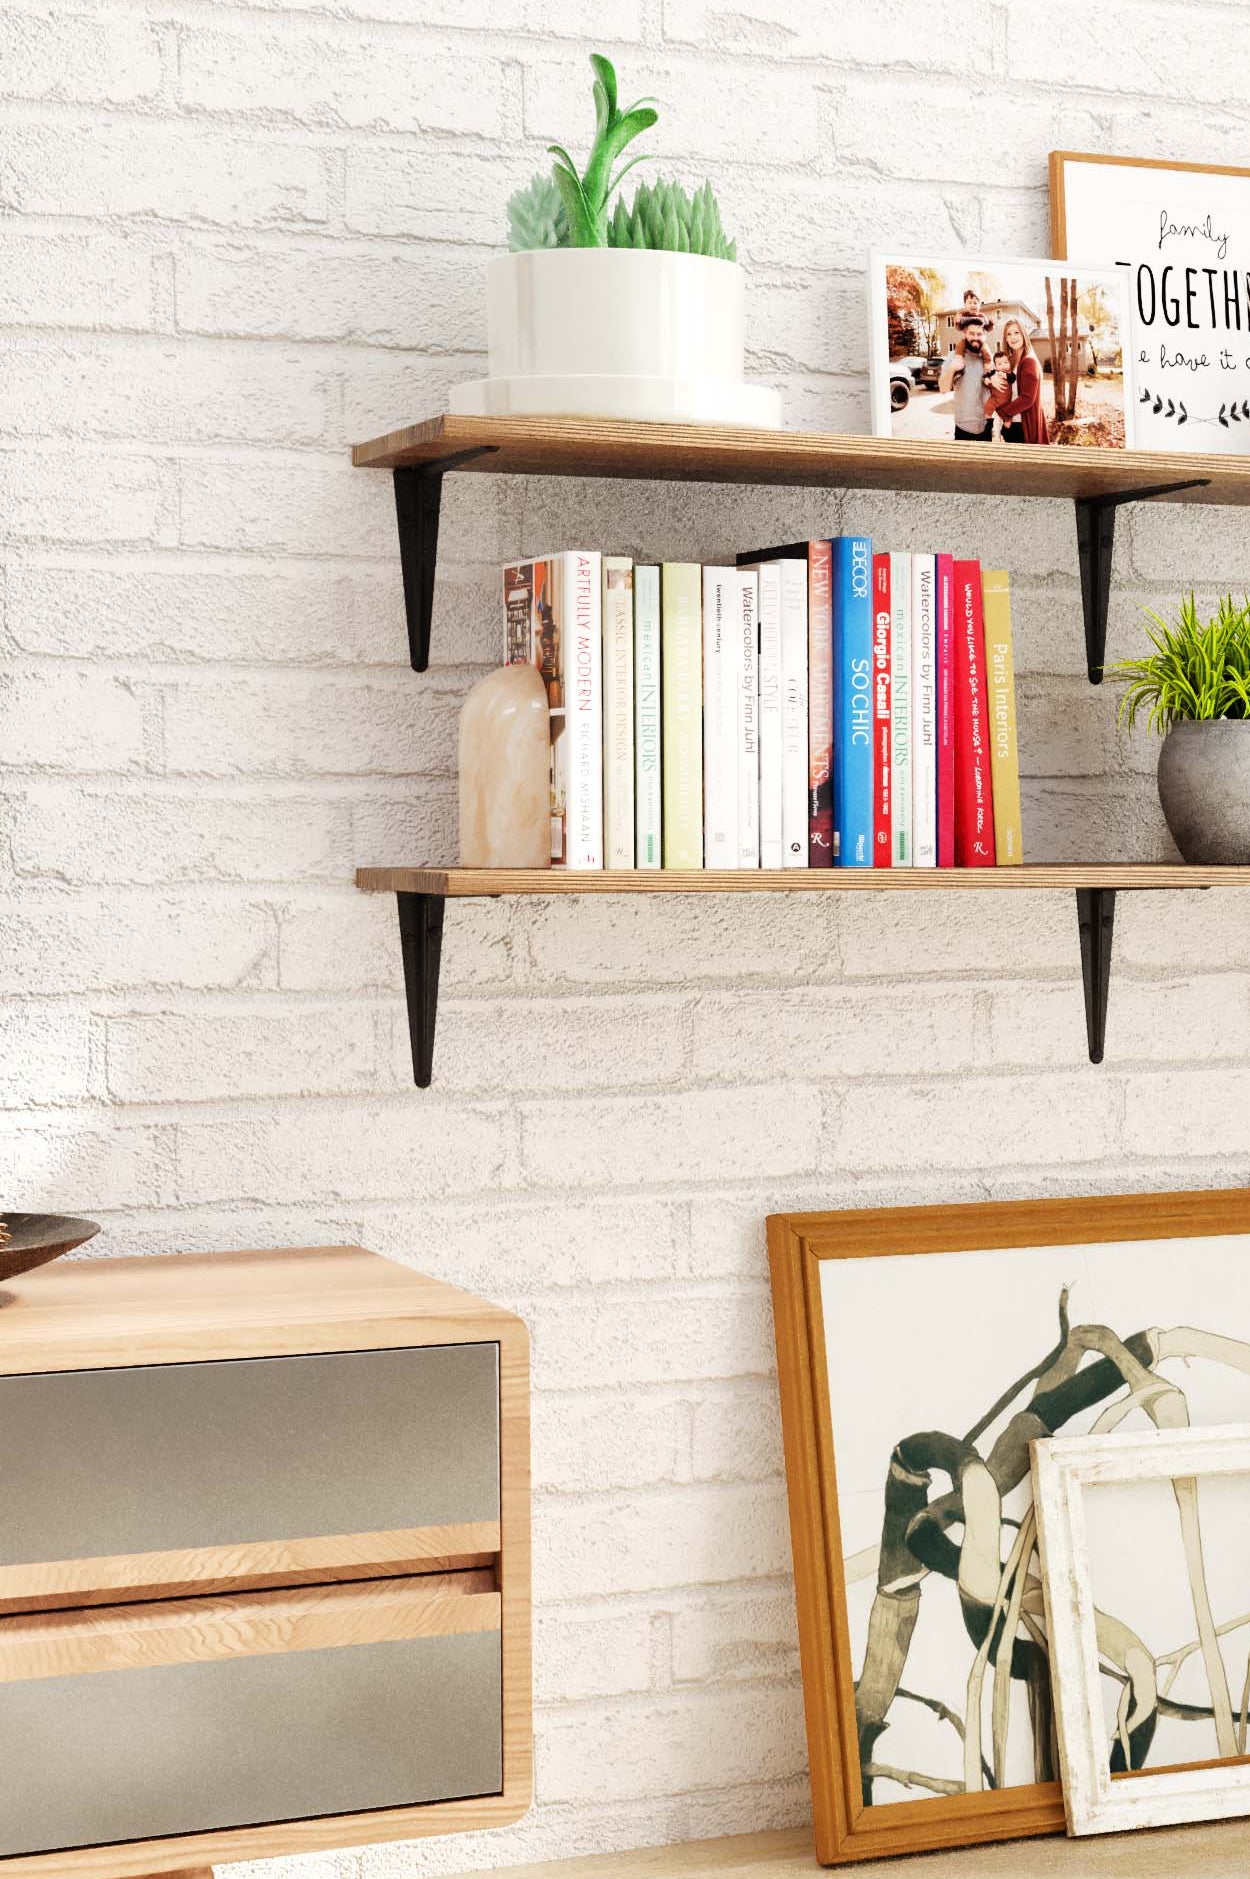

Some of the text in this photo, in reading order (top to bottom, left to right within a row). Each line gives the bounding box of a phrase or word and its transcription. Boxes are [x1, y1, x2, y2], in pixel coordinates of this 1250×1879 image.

[1158, 210, 1230, 260] family
[1138, 350, 1150, 363] e
[1160, 343, 1210, 372] have
[1220, 349, 1237, 370] it
[576, 556, 592, 631] ARTFULLY
[963, 583, 974, 617] WOULD
[642, 620, 654, 680] mexican
[876, 611, 891, 669] Giorgio
[895, 609, 905, 671] mexican
[965, 617, 976, 635] YOU
[578, 636, 593, 712] MODERN
[741, 586, 756, 753] Watercolors by Finn Juhl
[811, 555, 830, 778] NEW YORK APARTMENTS
[920, 570, 933, 746] Watercolors by Finn Juhl
[968, 662, 978, 675] TO
[851, 659, 870, 745] SO CHIC
[877, 671, 891, 719] Casali
[894, 674, 909, 767] INTERIORS
[971, 696, 981, 716] THE
[993, 643, 1011, 759] Paris Interiors
[641, 682, 657, 772] INTERIORS
